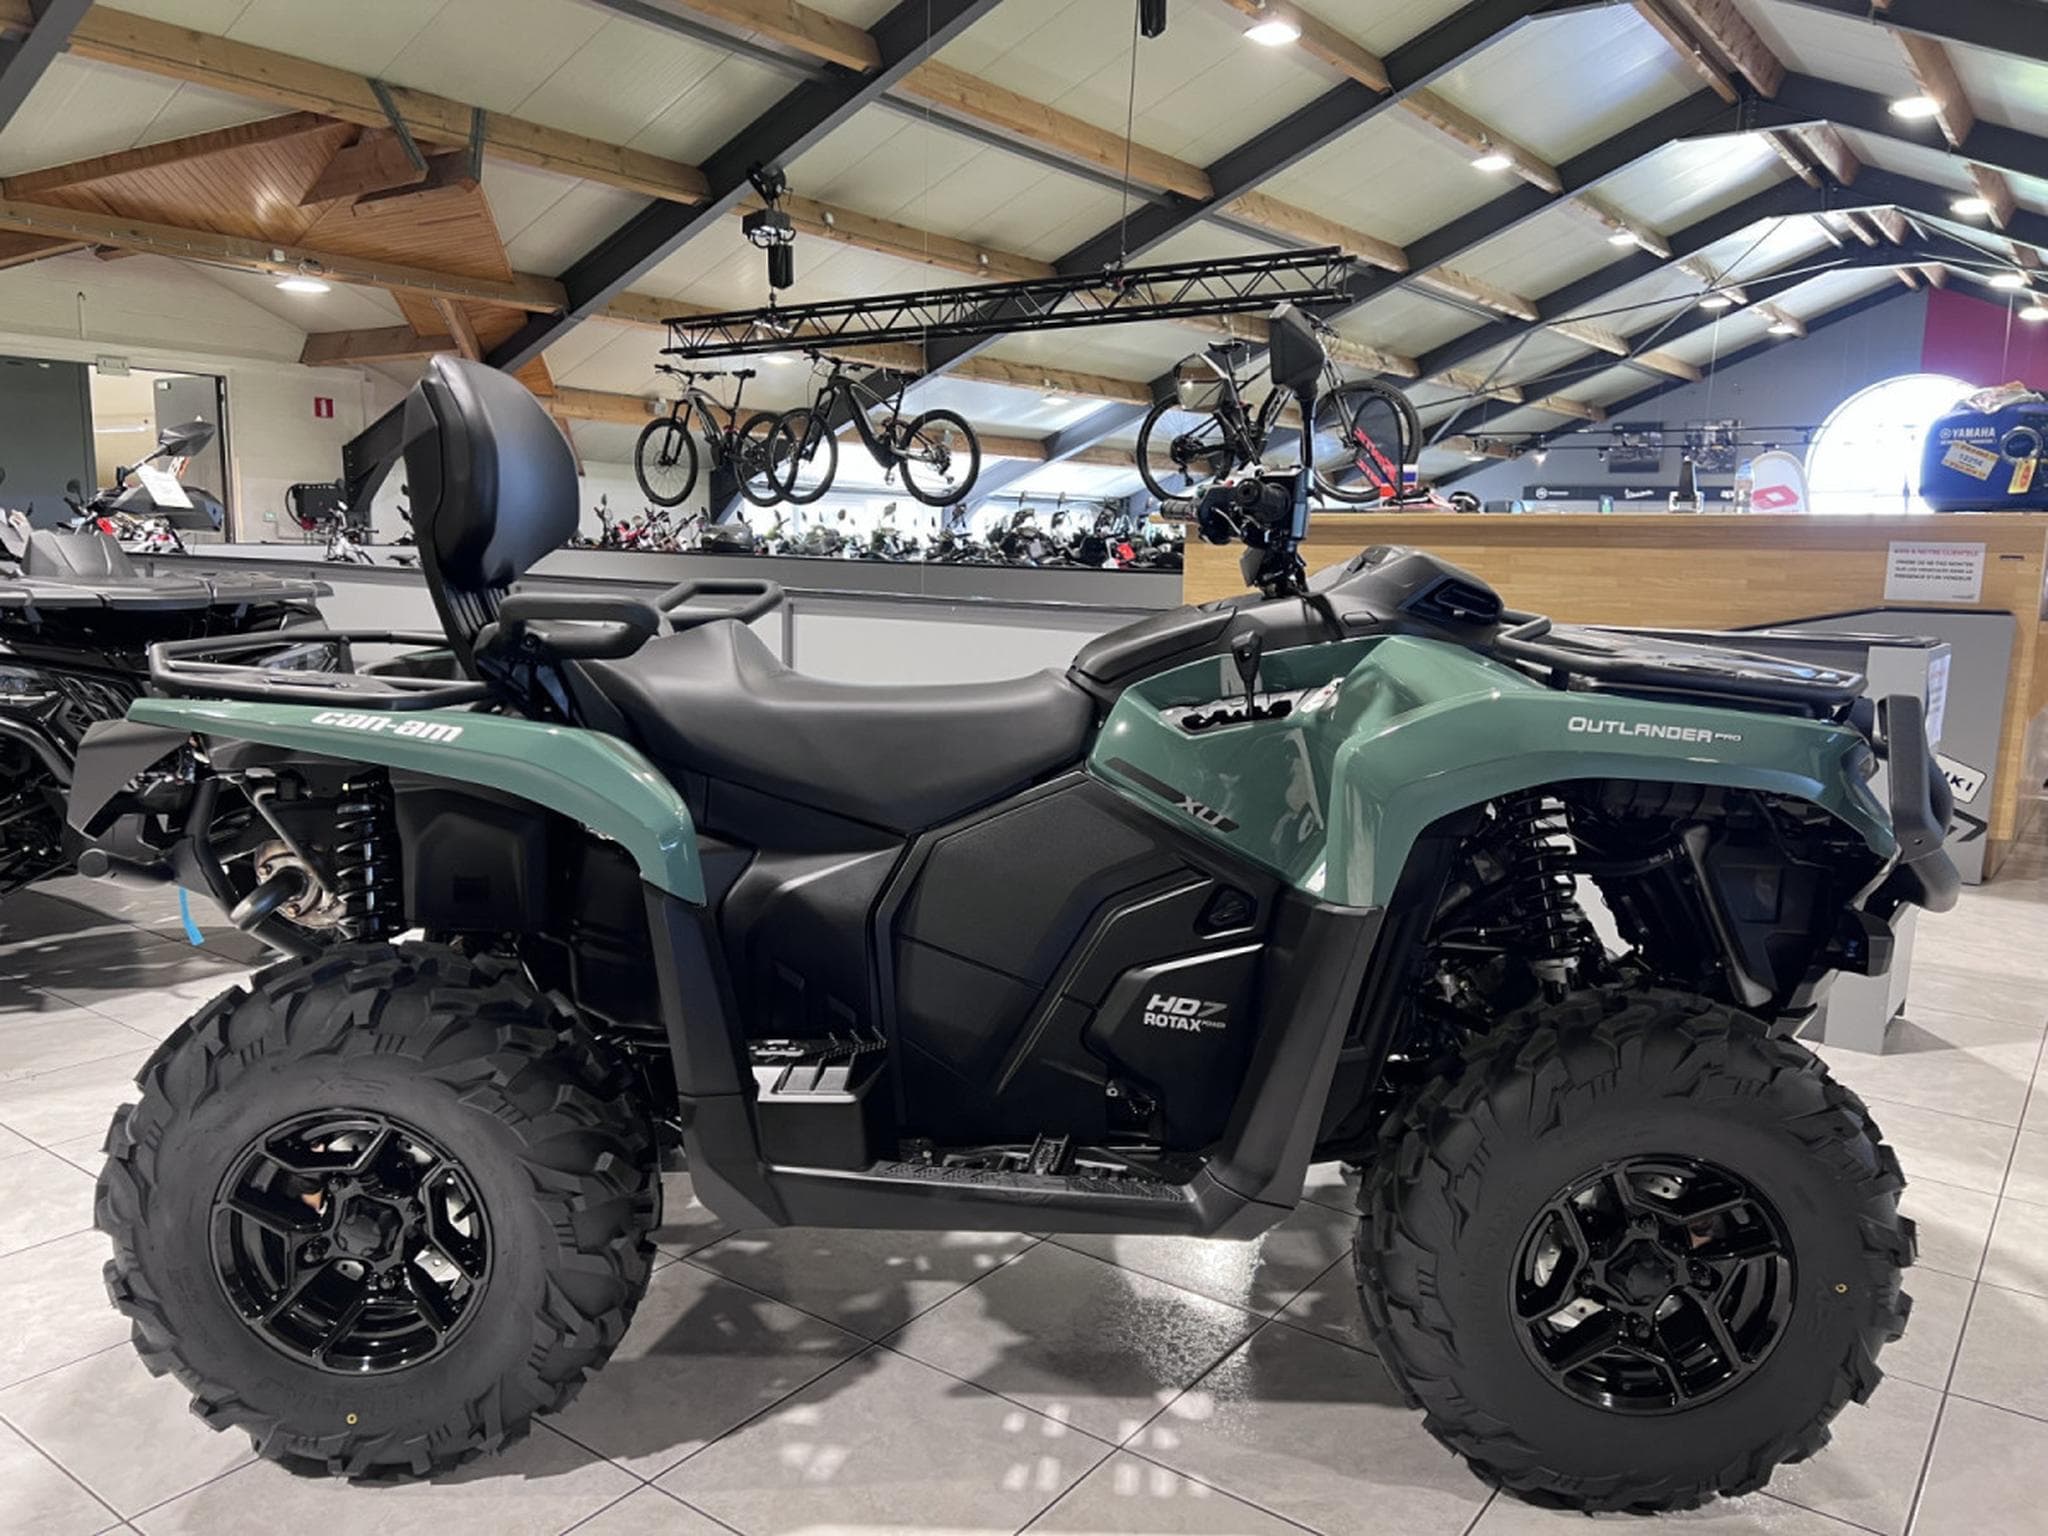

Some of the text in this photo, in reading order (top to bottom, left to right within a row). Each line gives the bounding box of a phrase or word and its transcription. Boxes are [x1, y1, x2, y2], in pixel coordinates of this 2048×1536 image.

[1952, 427, 1996, 439] YAMAHA
[1567, 716, 1742, 743] OUTLANDER PRO
[1146, 993, 1228, 1017] HD7
[1144, 1012, 1201, 1032] ROTAX
